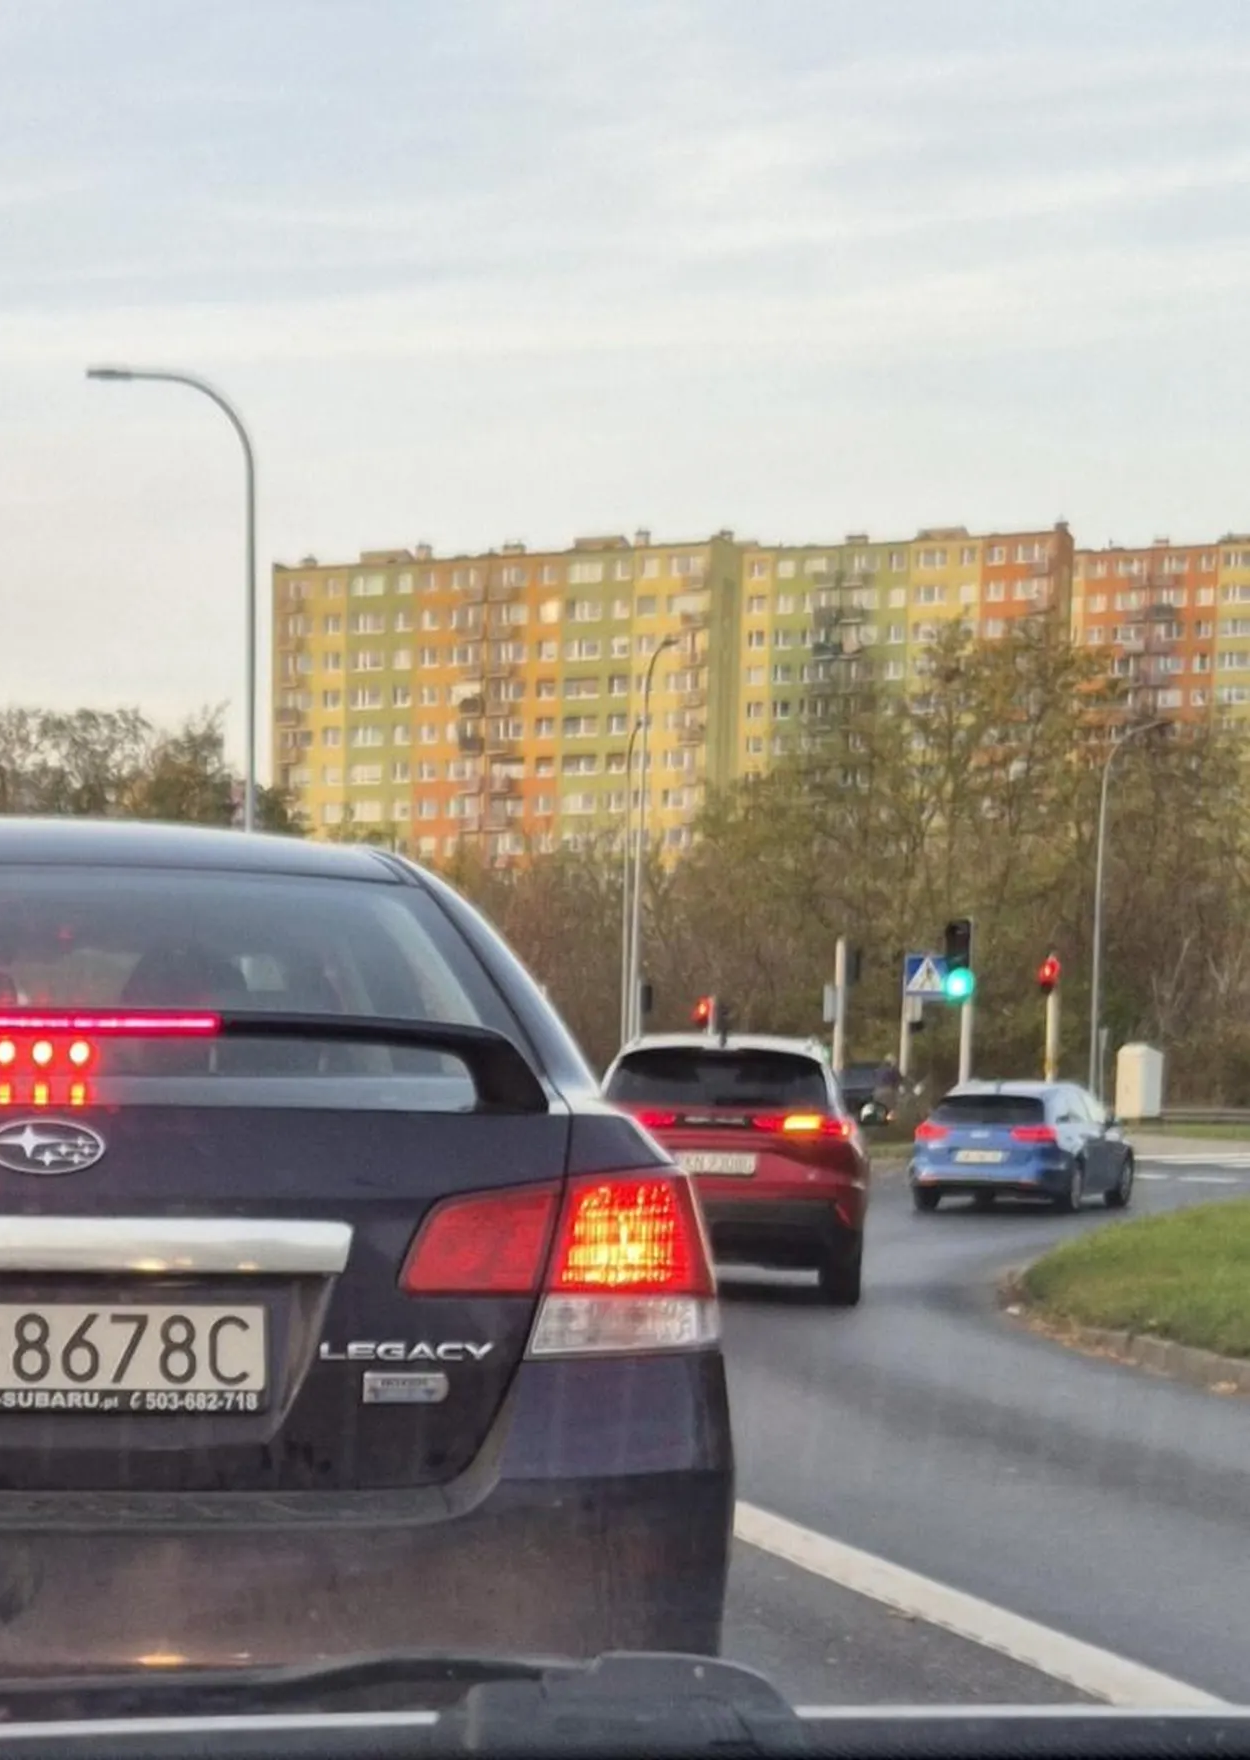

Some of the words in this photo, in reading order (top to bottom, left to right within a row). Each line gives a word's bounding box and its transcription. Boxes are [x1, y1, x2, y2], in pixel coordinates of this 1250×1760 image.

[13, 1314, 251, 1385] 8678C
[319, 1342, 493, 1361] LEGACY
[147, 1391, 258, 1411] 503-682-718
